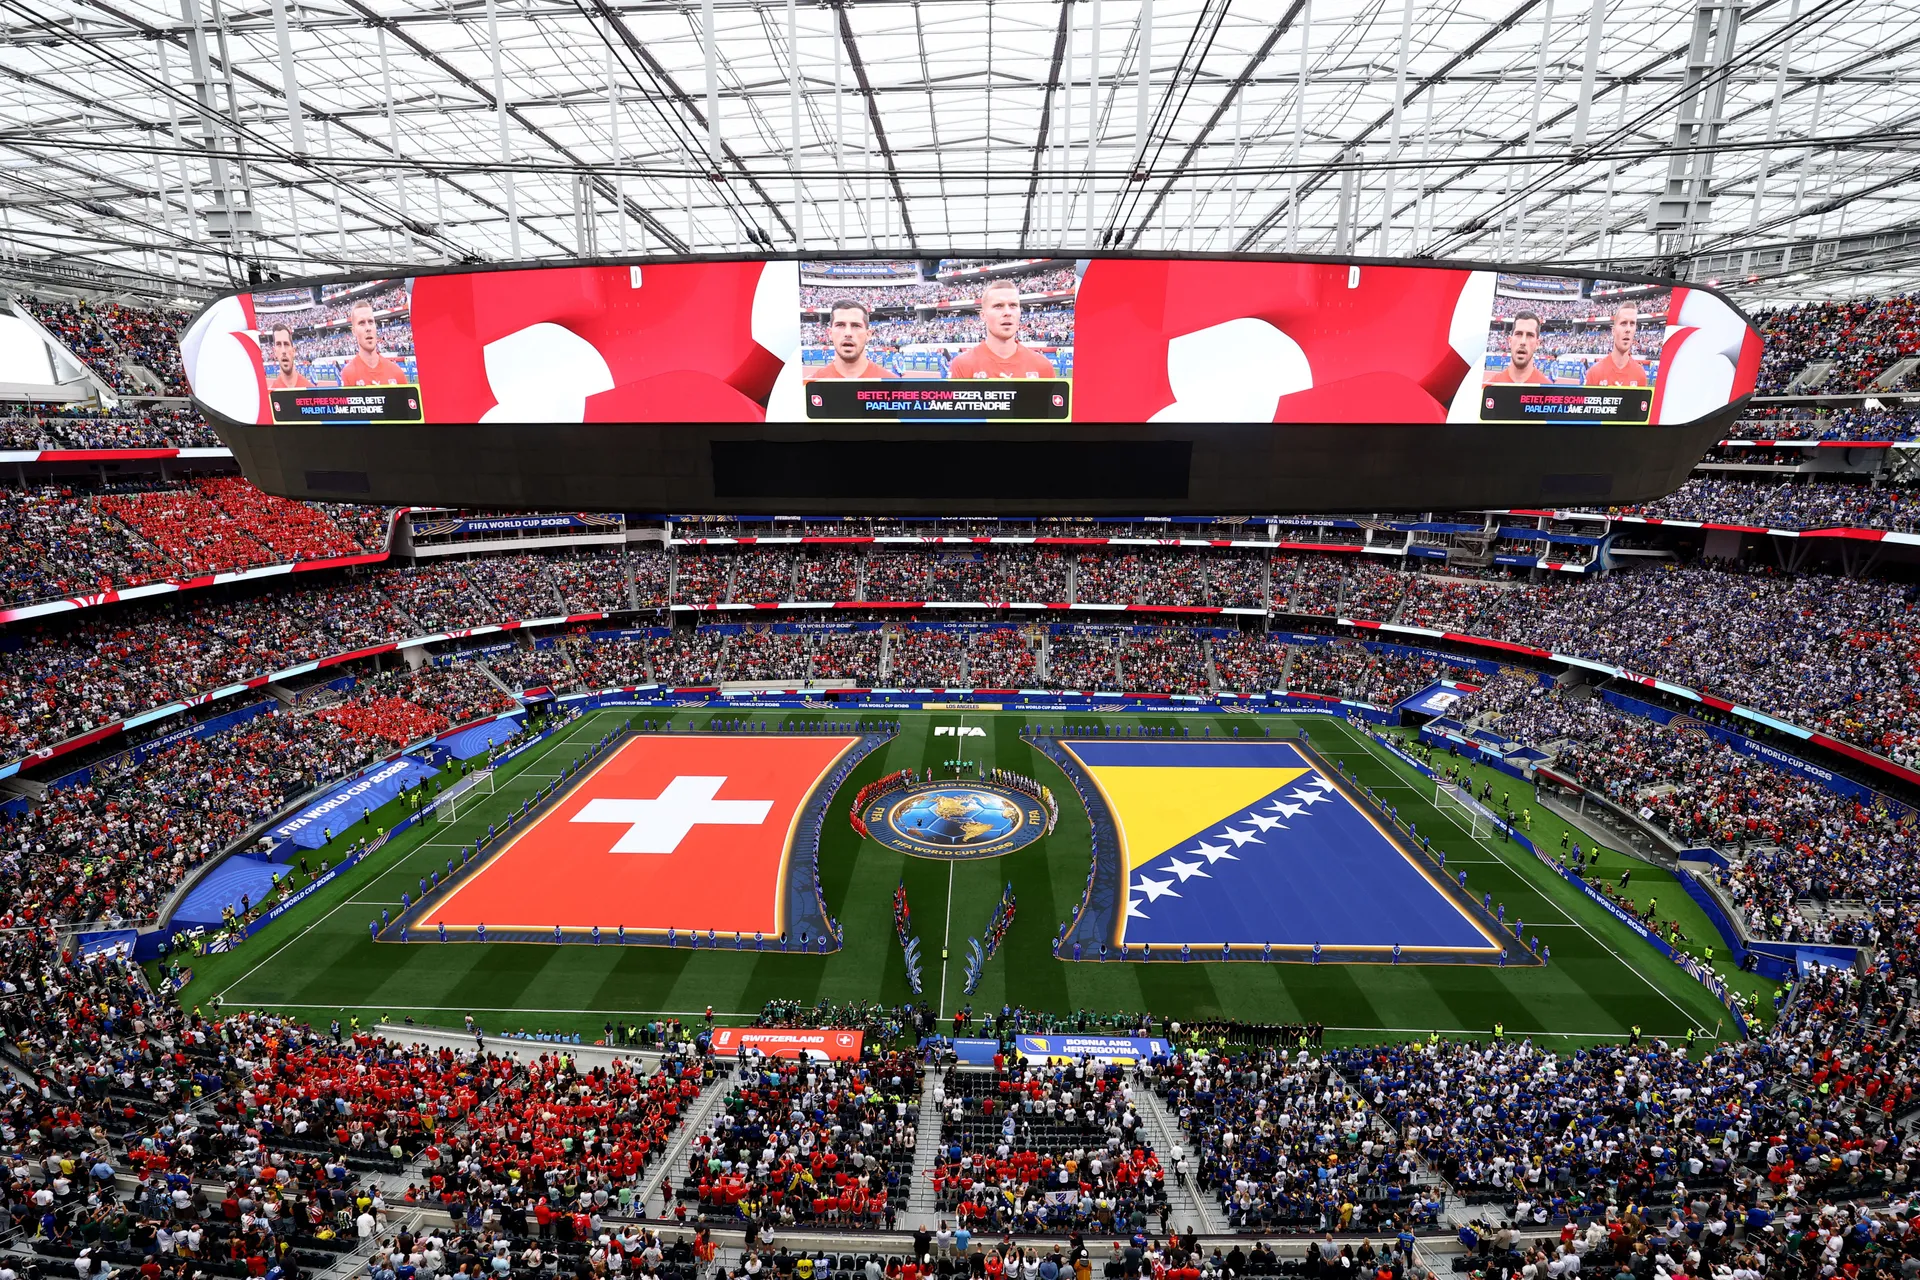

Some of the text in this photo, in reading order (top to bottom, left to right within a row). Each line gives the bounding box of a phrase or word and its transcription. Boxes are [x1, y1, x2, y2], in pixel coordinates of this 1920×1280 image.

[857, 391, 1016, 401] BETET, FREIE SCHWEIZER, BETET
[866, 400, 1010, 410] PARLENT À L'ÂME ATTENDRIE
[1439, 654, 1476, 664] ANGELES
[163, 724, 205, 744] ANGELES
[934, 726, 987, 737] FIFA
[1745, 740, 1832, 781] FIFA WORLD CUP 2026
[277, 761, 410, 835] FIFA WORLD CUP 2026
[871, 807, 885, 823] FIFA
[1028, 810, 1040, 825] FIFA
[1500, 822, 1513, 835] 206
[892, 839, 1014, 855] FIFA WORLD CUP 2026
[270, 871, 336, 919] FIFA WORLD CUP 2026
[1585, 886, 1648, 937] FIFA WORLD CUP 2026
[741, 1034, 824, 1043] SWITZERLAND
[1063, 1046, 1139, 1054] HERZEGOVINA
